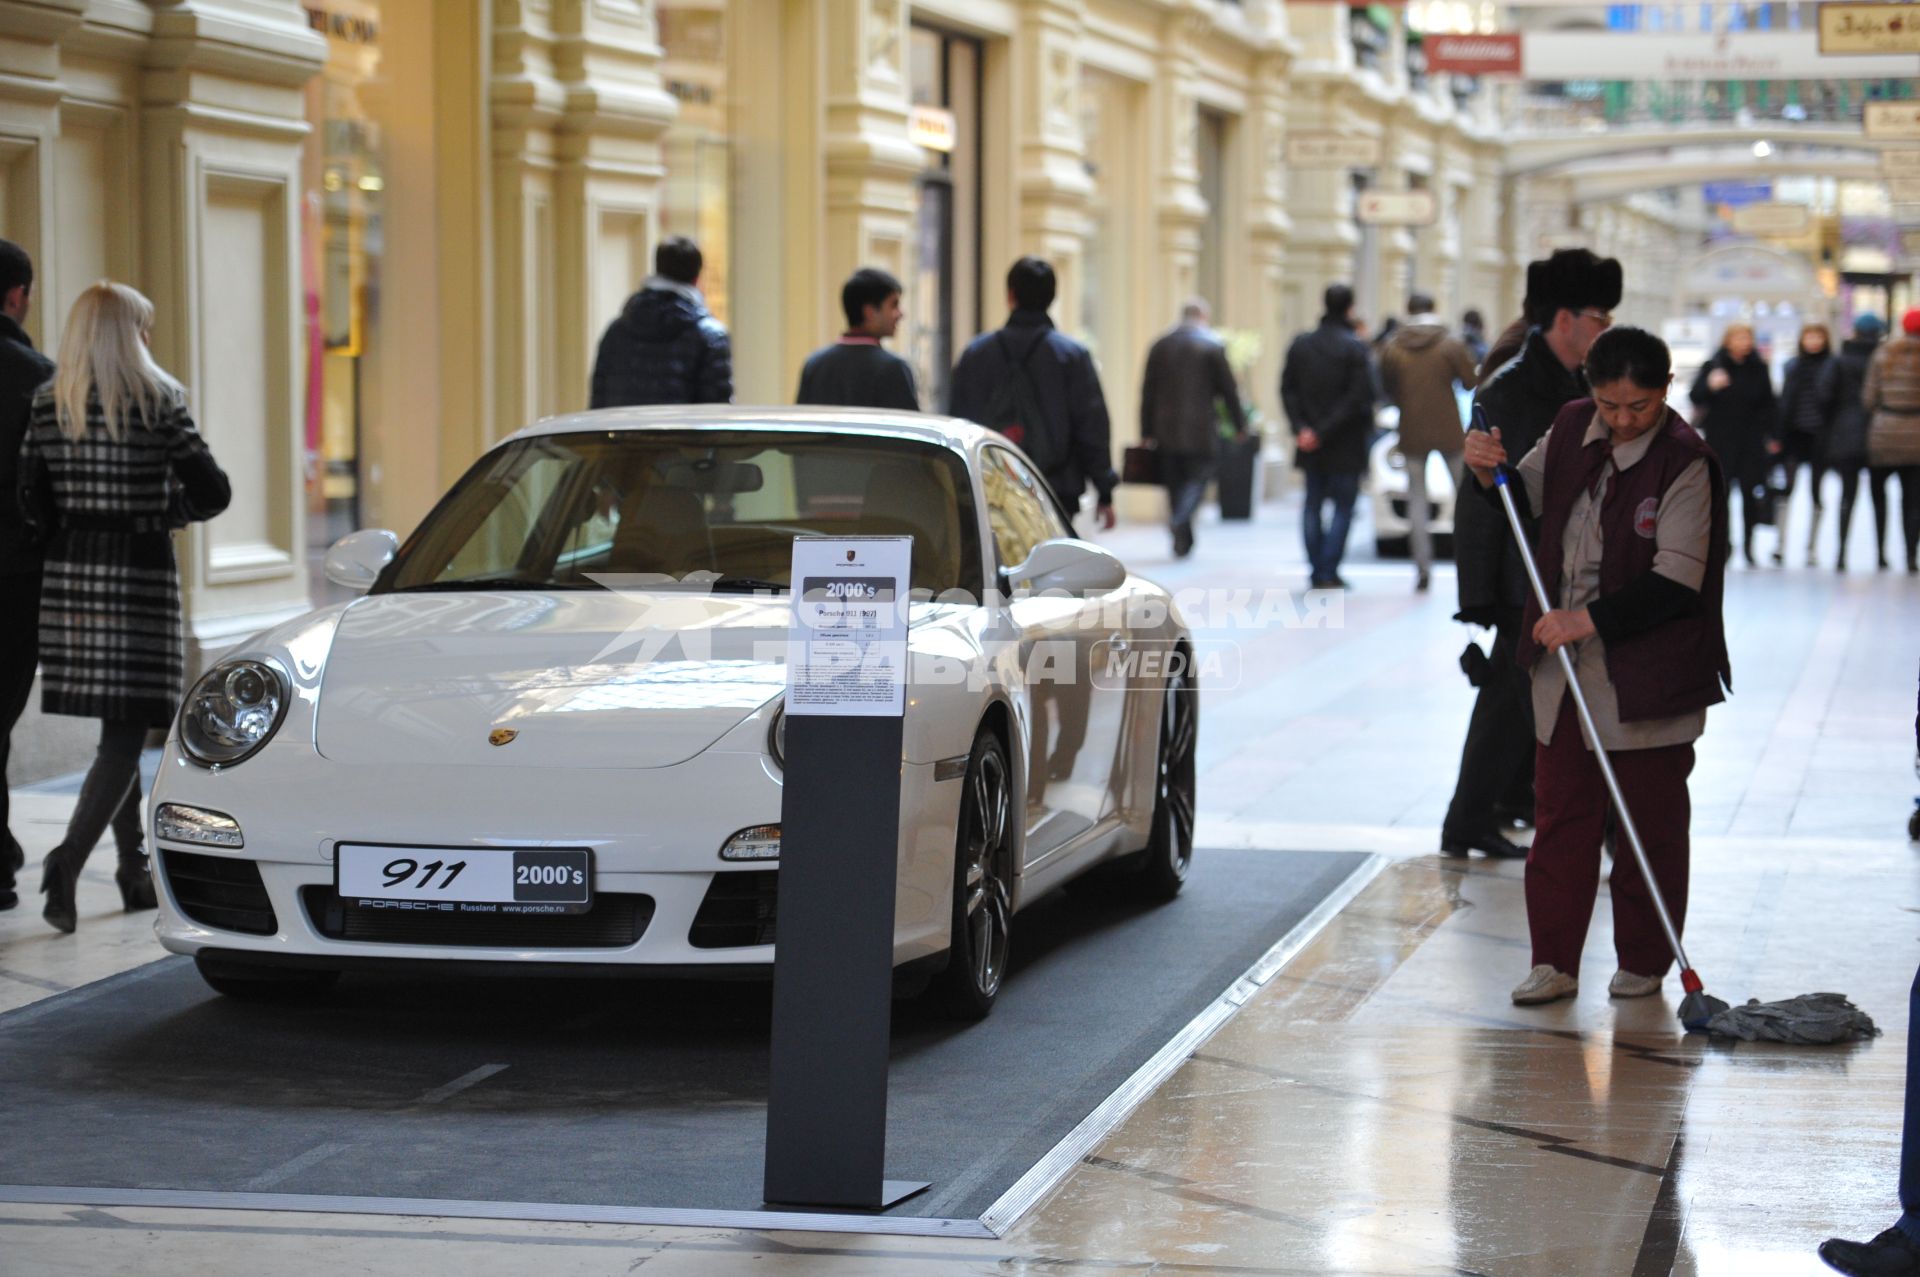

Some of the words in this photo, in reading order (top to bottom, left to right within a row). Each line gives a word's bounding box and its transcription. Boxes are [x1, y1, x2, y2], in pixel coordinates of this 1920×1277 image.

[819, 609, 844, 617] Porsche
[846, 609, 857, 617] 911
[381, 858, 467, 890] 911
[358, 899, 455, 911] PORSCHE
[460, 903, 496, 912] Russland
[502, 904, 565, 914] www.porsche.ru
